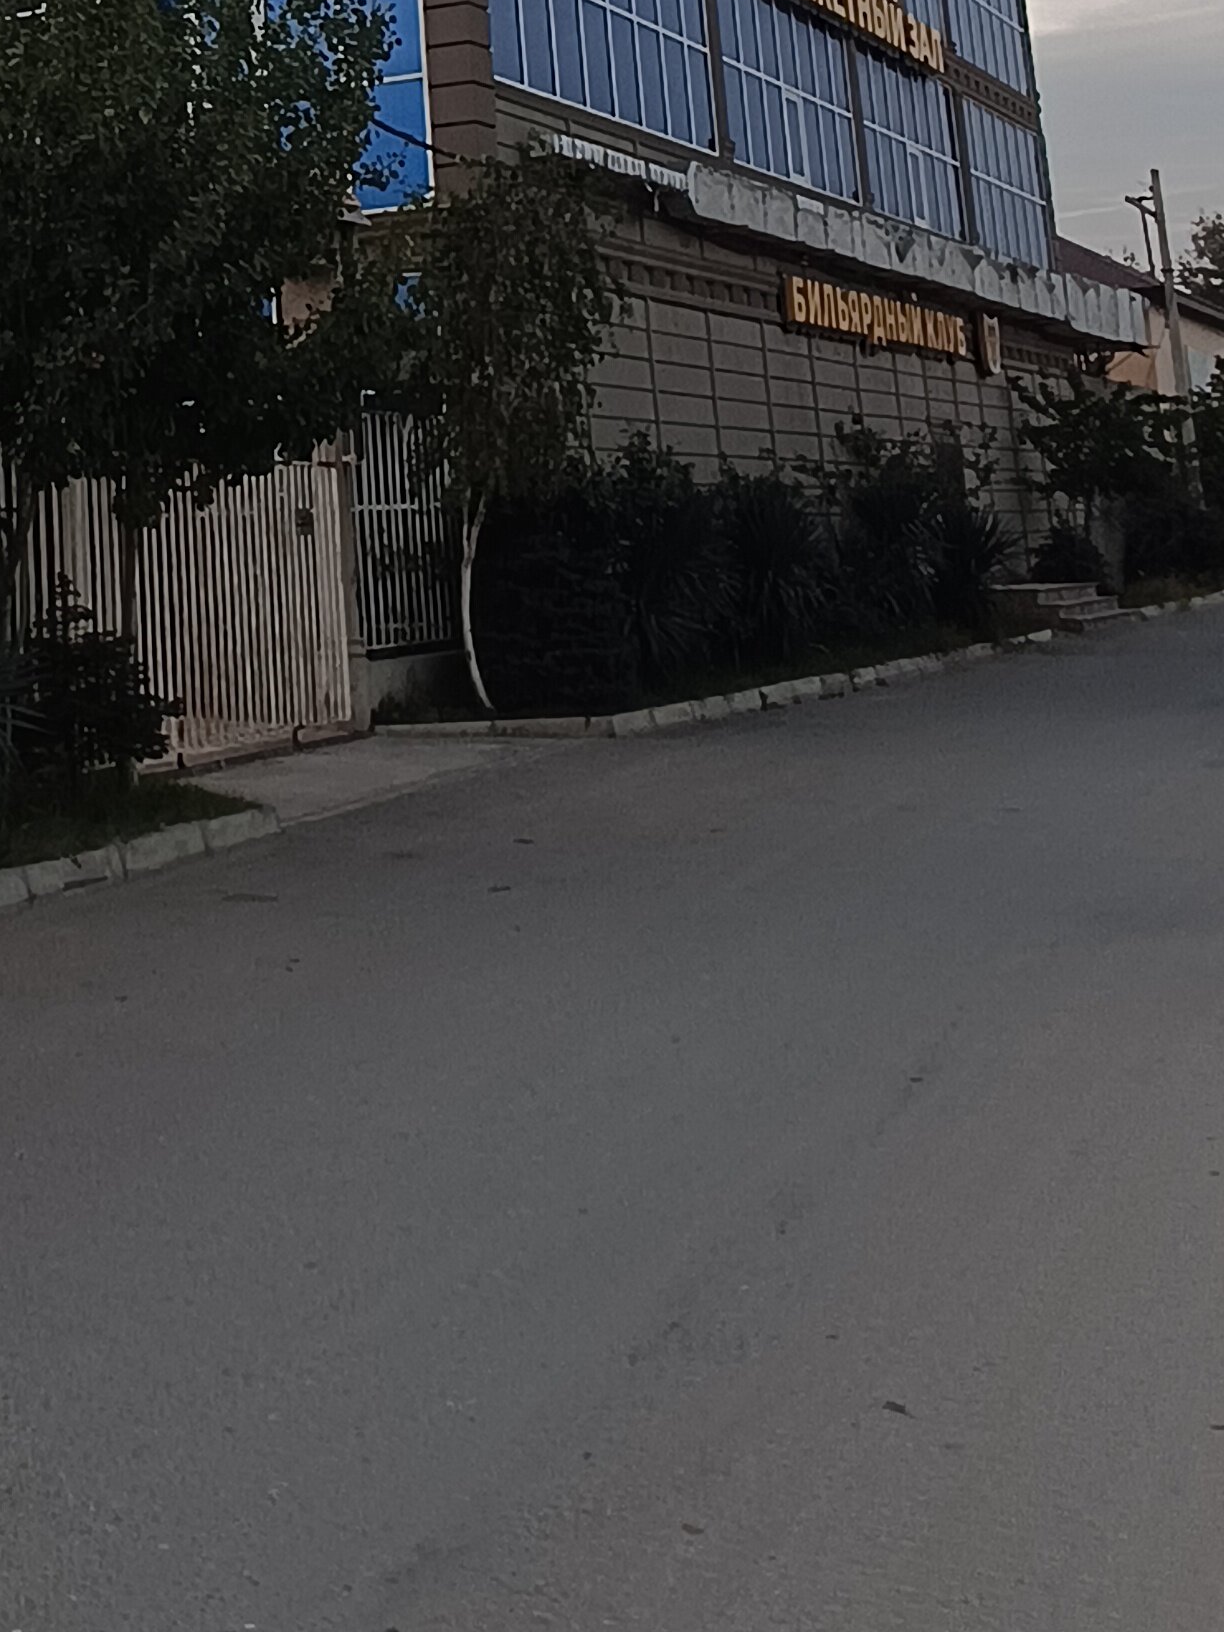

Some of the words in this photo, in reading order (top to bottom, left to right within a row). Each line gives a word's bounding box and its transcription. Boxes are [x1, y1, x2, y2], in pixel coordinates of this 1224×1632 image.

[907, 12, 946, 74] ЗАЛ
[791, 275, 924, 347] БИЛЬЯРДНЫЙ
[925, 308, 967, 357] КЛУБ
